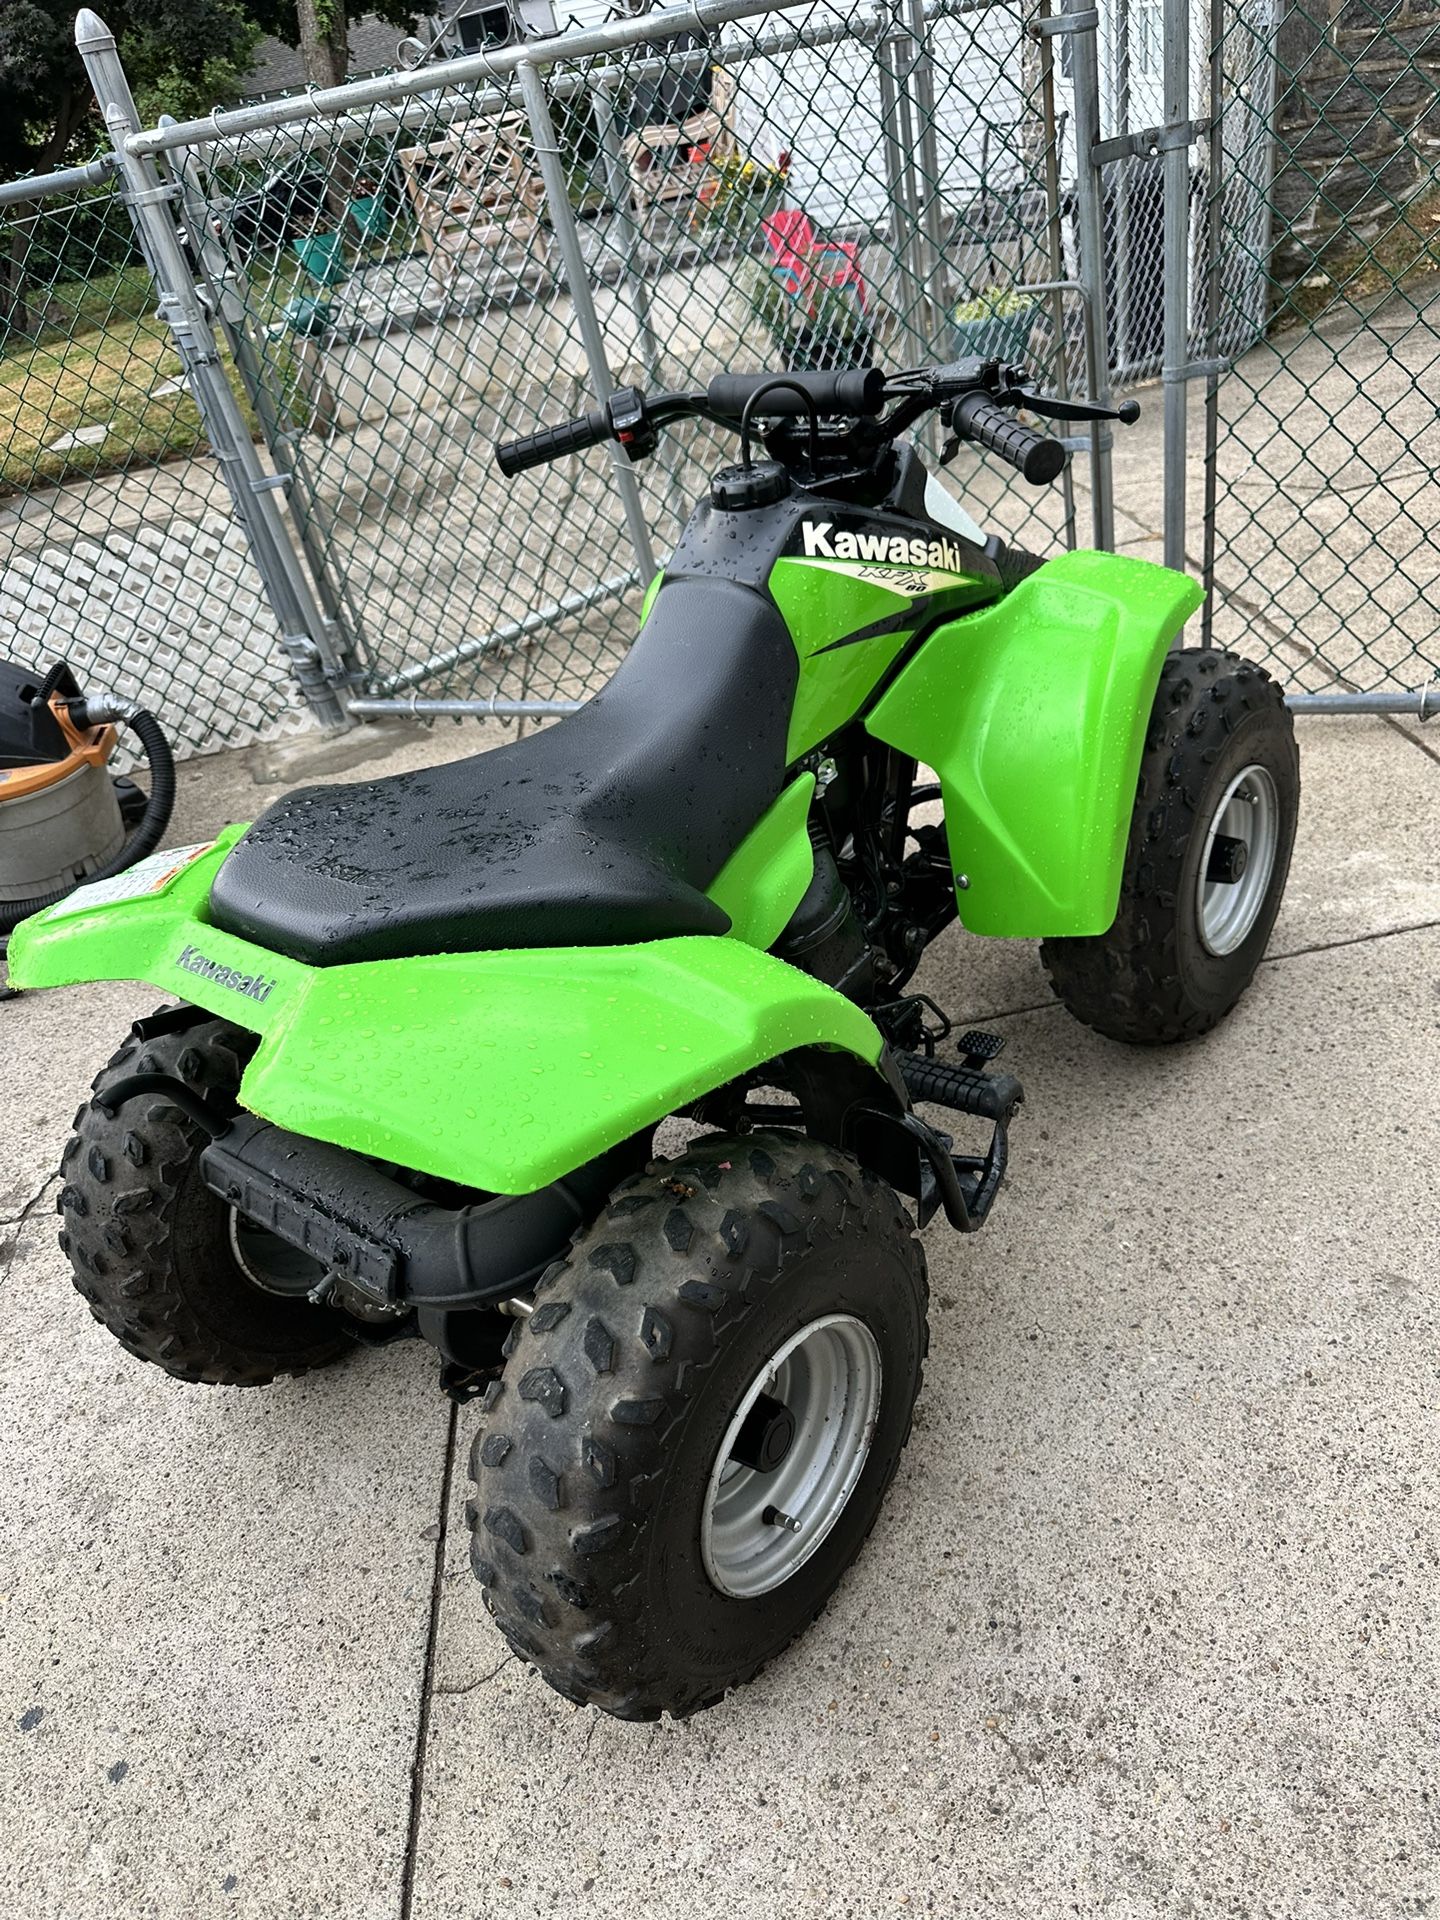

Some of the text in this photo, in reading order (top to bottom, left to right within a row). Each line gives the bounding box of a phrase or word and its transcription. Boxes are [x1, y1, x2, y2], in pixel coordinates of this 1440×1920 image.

[802, 521, 961, 573] Kawasaki
[858, 566, 930, 586] KFX
[177, 945, 277, 1003] Kawasaki
